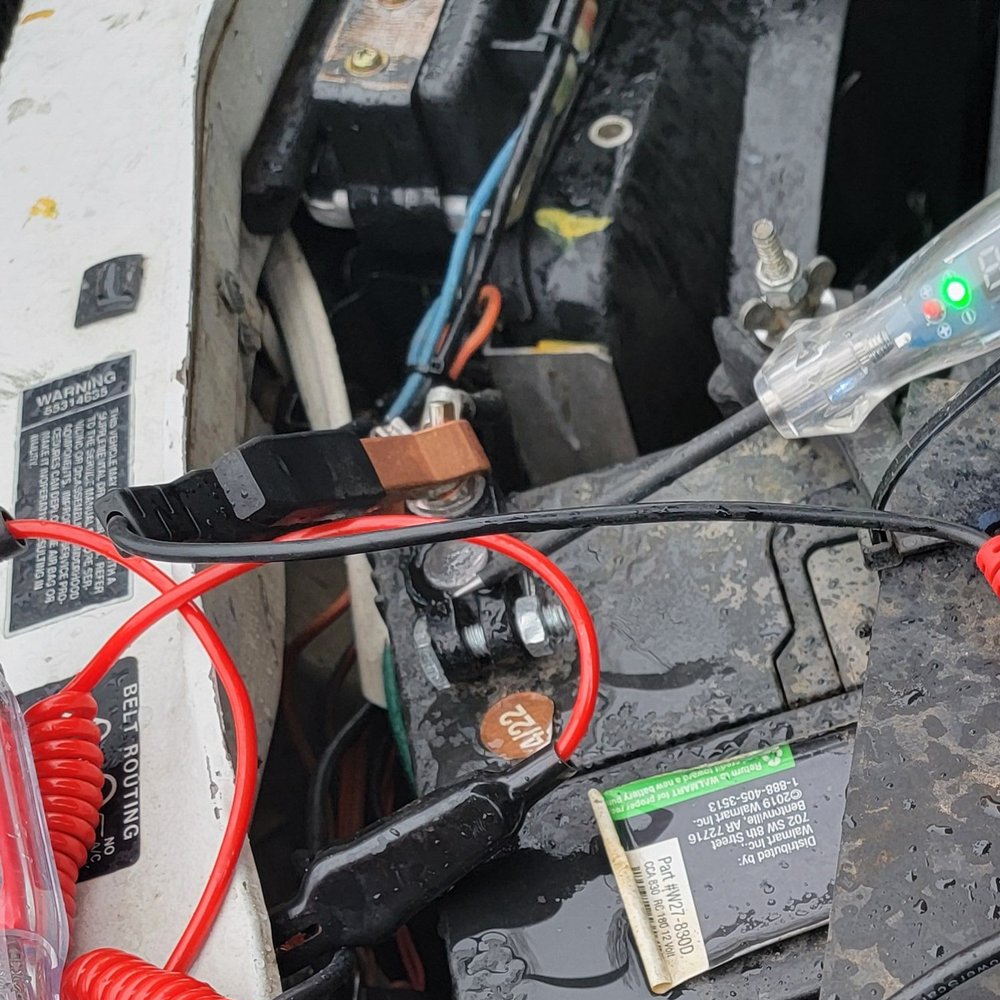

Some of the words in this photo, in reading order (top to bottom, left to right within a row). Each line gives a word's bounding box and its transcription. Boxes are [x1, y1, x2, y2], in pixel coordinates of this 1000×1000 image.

[35, 371, 117, 408] WARNING
[109, 407, 119, 429] THIS
[40, 430, 51, 455] MAKE
[74, 419, 85, 450] VICING
[85, 430, 96, 448] THE
[50, 426, 62, 470] CEDURES
[96, 411, 108, 481] SUPPLEMENTAL
[108, 431, 118, 467] VEHICLE
[84, 449, 95, 488] SERVICE
[107, 468, 118, 487] MAY
[50, 471, 61, 490] CAN
[84, 489, 95, 527] MANUAL
[47, 552, 59, 568] AIR
[58, 542, 71, 580] SERVICE
[46, 569, 58, 588] BAG
[94, 562, 105, 595] REFER
[44, 590, 56, 603] OR
[122, 683, 138, 733] BELT
[499, 704, 545, 749] 4/22
[682, 766, 714, 784] toward
[731, 762, 763, 778] Return
[122, 743, 139, 841] ROUTING
[622, 783, 657, 801] battery
[657, 779, 674, 790] new
[674, 775, 720, 799] WALMART
[626, 795, 656, 813] proper
[659, 791, 672, 802] for
[708, 777, 799, 812] 1-888-405-3513
[762, 788, 803, 809] ©2019
[693, 815, 714, 827] Inc.
[715, 801, 761, 823] Walmart
[743, 799, 806, 825] Bentonville,
[787, 812, 810, 827] 702
[688, 825, 725, 845] 72716
[725, 819, 741, 834] AR
[745, 825, 765, 839] 8th
[767, 819, 786, 834] SW
[767, 823, 814, 846] Walmart
[103, 836, 115, 856] NO
[711, 831, 745, 851] Street
[741, 838, 766, 851] Inc.,
[757, 835, 817, 863] Distributed
[644, 861, 656, 878] CCA
[657, 856, 676, 881] Part
[737, 853, 756, 867] by:
[648, 880, 661, 896] 830
[653, 899, 665, 911] RC
[657, 913, 669, 929] 180
[661, 930, 672, 941] 12
[664, 941, 677, 958] Volt
